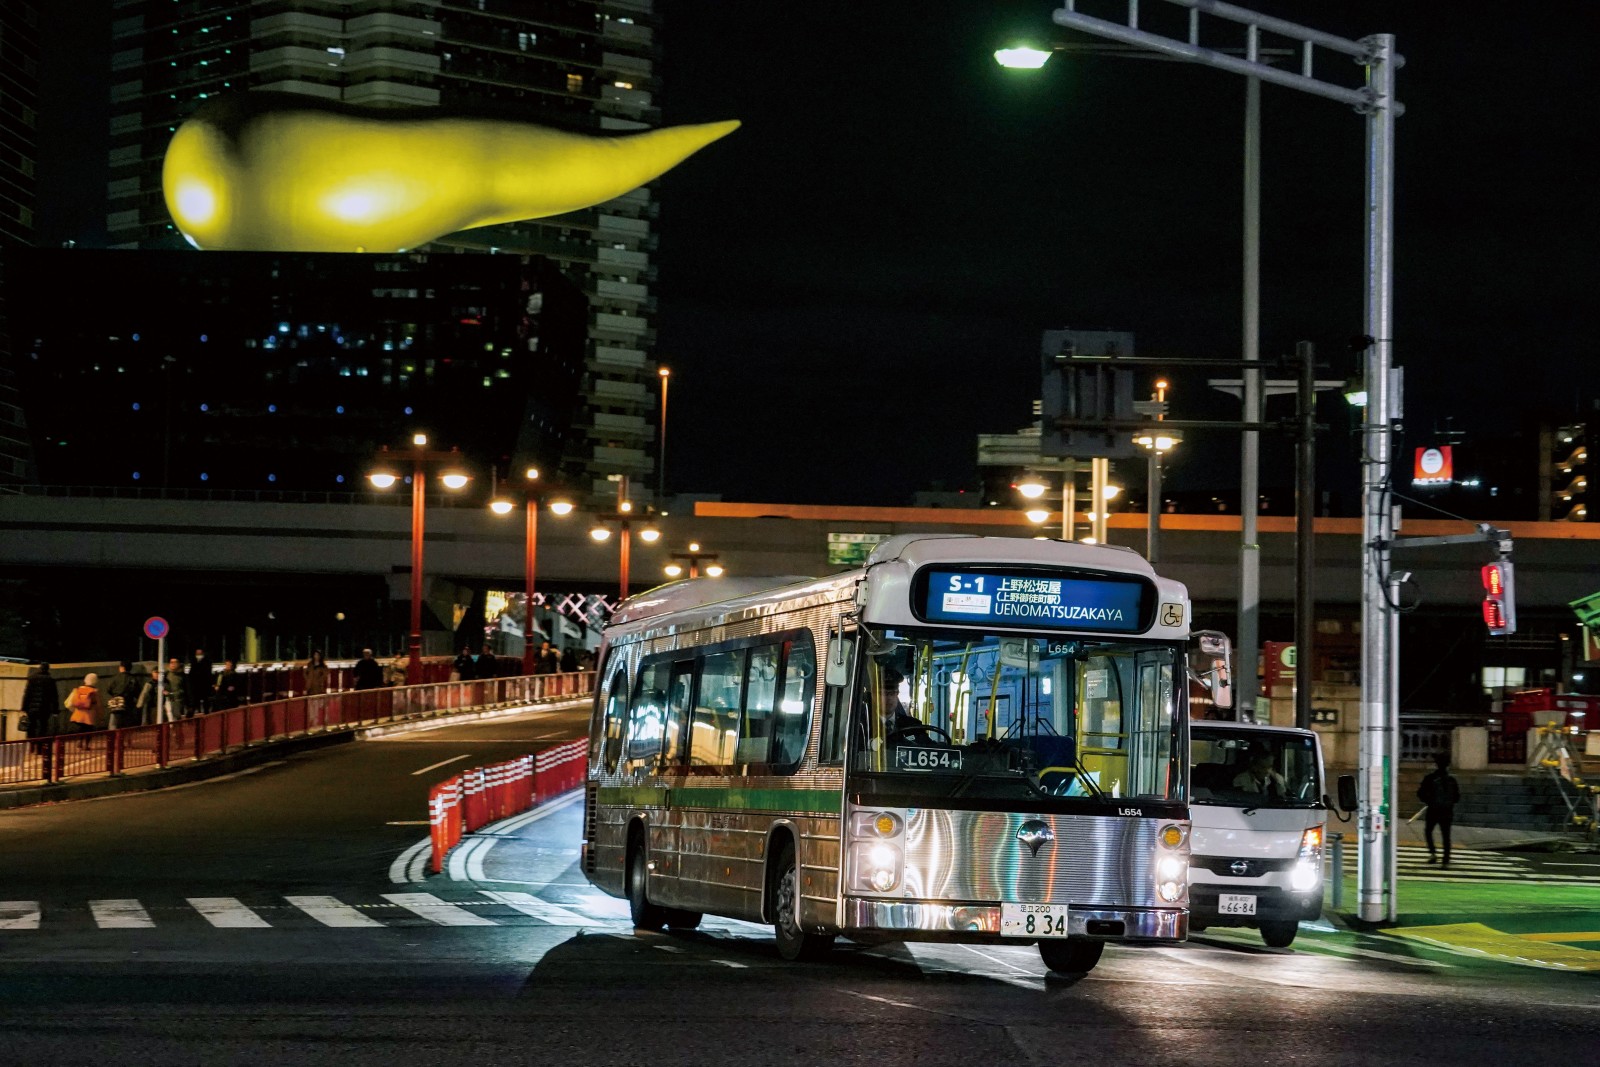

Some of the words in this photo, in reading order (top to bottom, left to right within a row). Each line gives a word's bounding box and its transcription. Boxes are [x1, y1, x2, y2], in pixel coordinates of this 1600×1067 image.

[949, 575, 984, 593] S-1
[997, 578, 1061, 594] 上野松坂屋
[995, 603, 1123, 621] UENOMATSUZAKAYA
[1048, 644, 1075, 654] L654
[908, 750, 950, 767] L654
[1118, 807, 1142, 816] L654
[1227, 902, 1254, 913] 66-84
